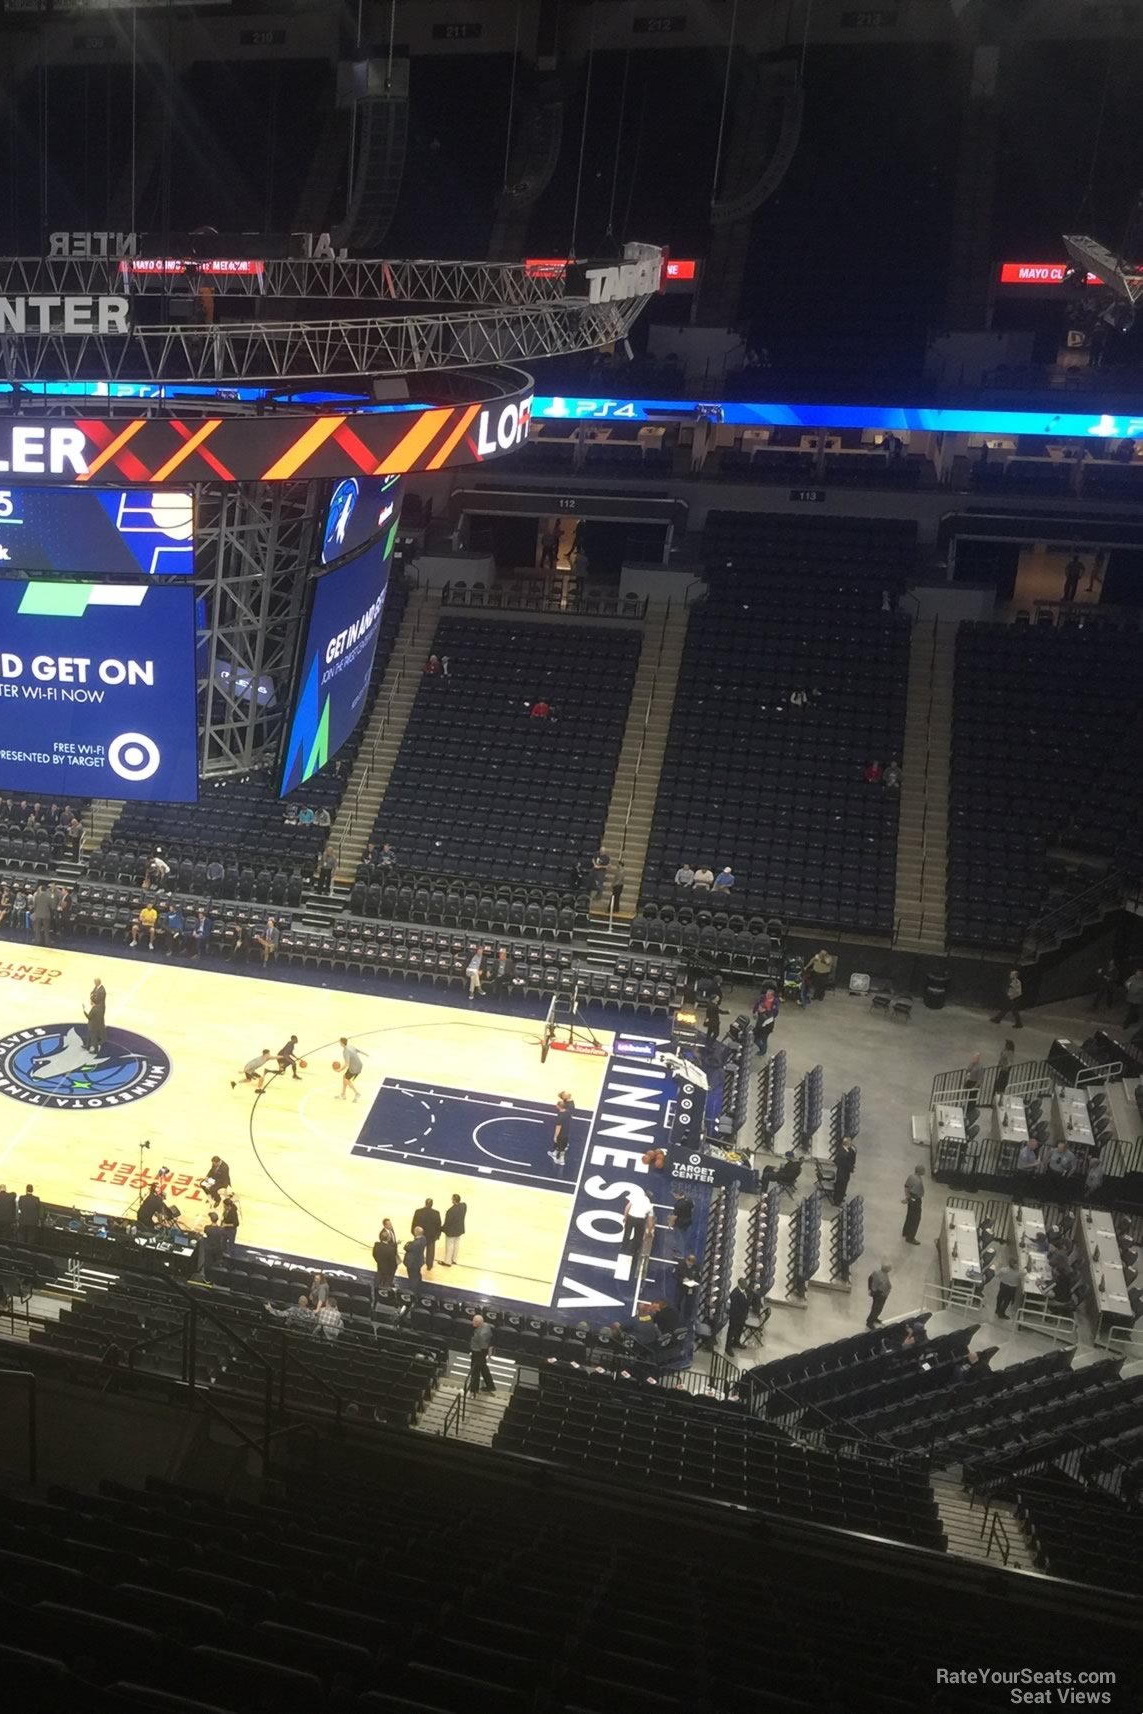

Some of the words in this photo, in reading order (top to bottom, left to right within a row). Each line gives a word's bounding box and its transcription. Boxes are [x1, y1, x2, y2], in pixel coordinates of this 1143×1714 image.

[1019, 268, 1048, 279] MAYO
[576, 401, 637, 418] PS4
[799, 491, 818, 502] 113
[559, 499, 577, 509] 112
[326, 629, 348, 664] GET
[346, 620, 360, 650] IN
[31, 655, 90, 683] GET
[98, 659, 154, 686] ON
[22, 686, 58, 701] WI-FI
[62, 689, 105, 704] NOW
[53, 742, 75, 754] FREE
[77, 744, 105, 755] WI-FI
[53, 755, 66, 765] BY
[67, 755, 105, 768] TARGET
[56, 1065, 165, 1108] MINNESOTA
[673, 1162, 716, 1176] TARGET
[672, 1169, 714, 1184] CENTER
